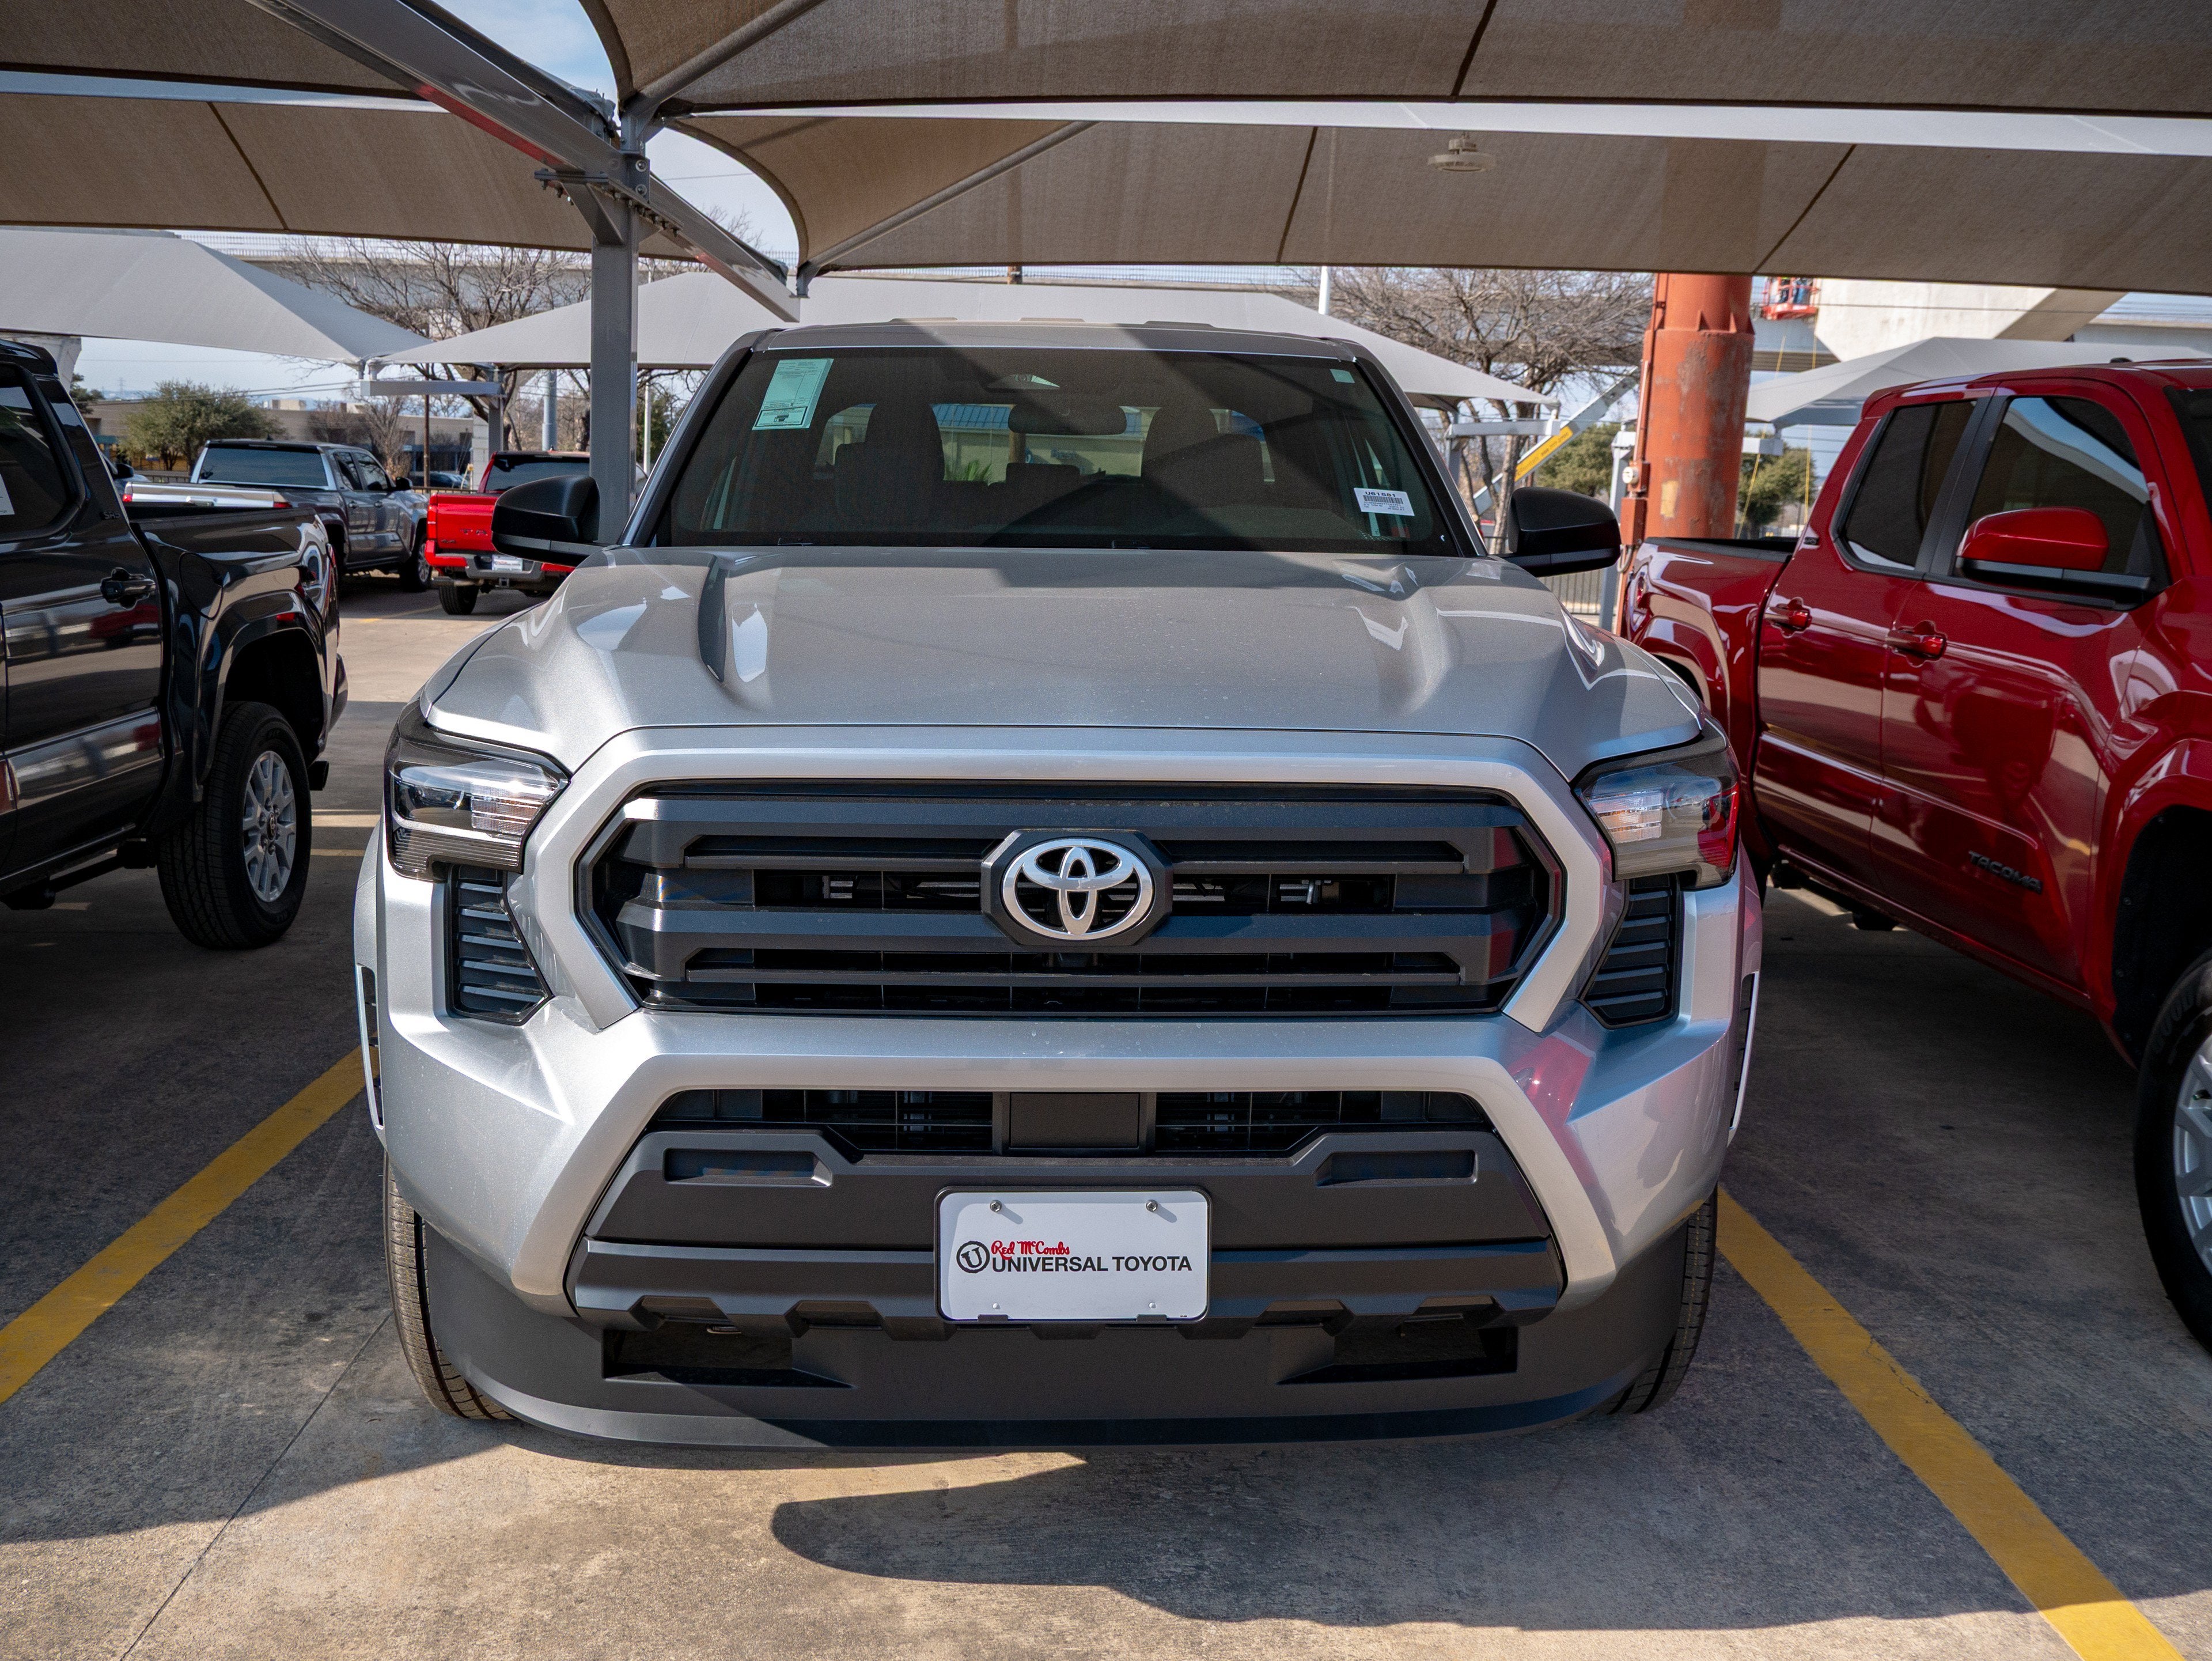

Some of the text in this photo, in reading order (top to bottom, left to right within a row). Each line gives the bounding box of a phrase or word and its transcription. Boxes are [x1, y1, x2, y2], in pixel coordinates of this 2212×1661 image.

[1968, 849, 2043, 894] TACOMA
[991, 1240, 1070, 1260] Red McCombs
[992, 1255, 1192, 1272] UNIVERSAL TOYOTA
